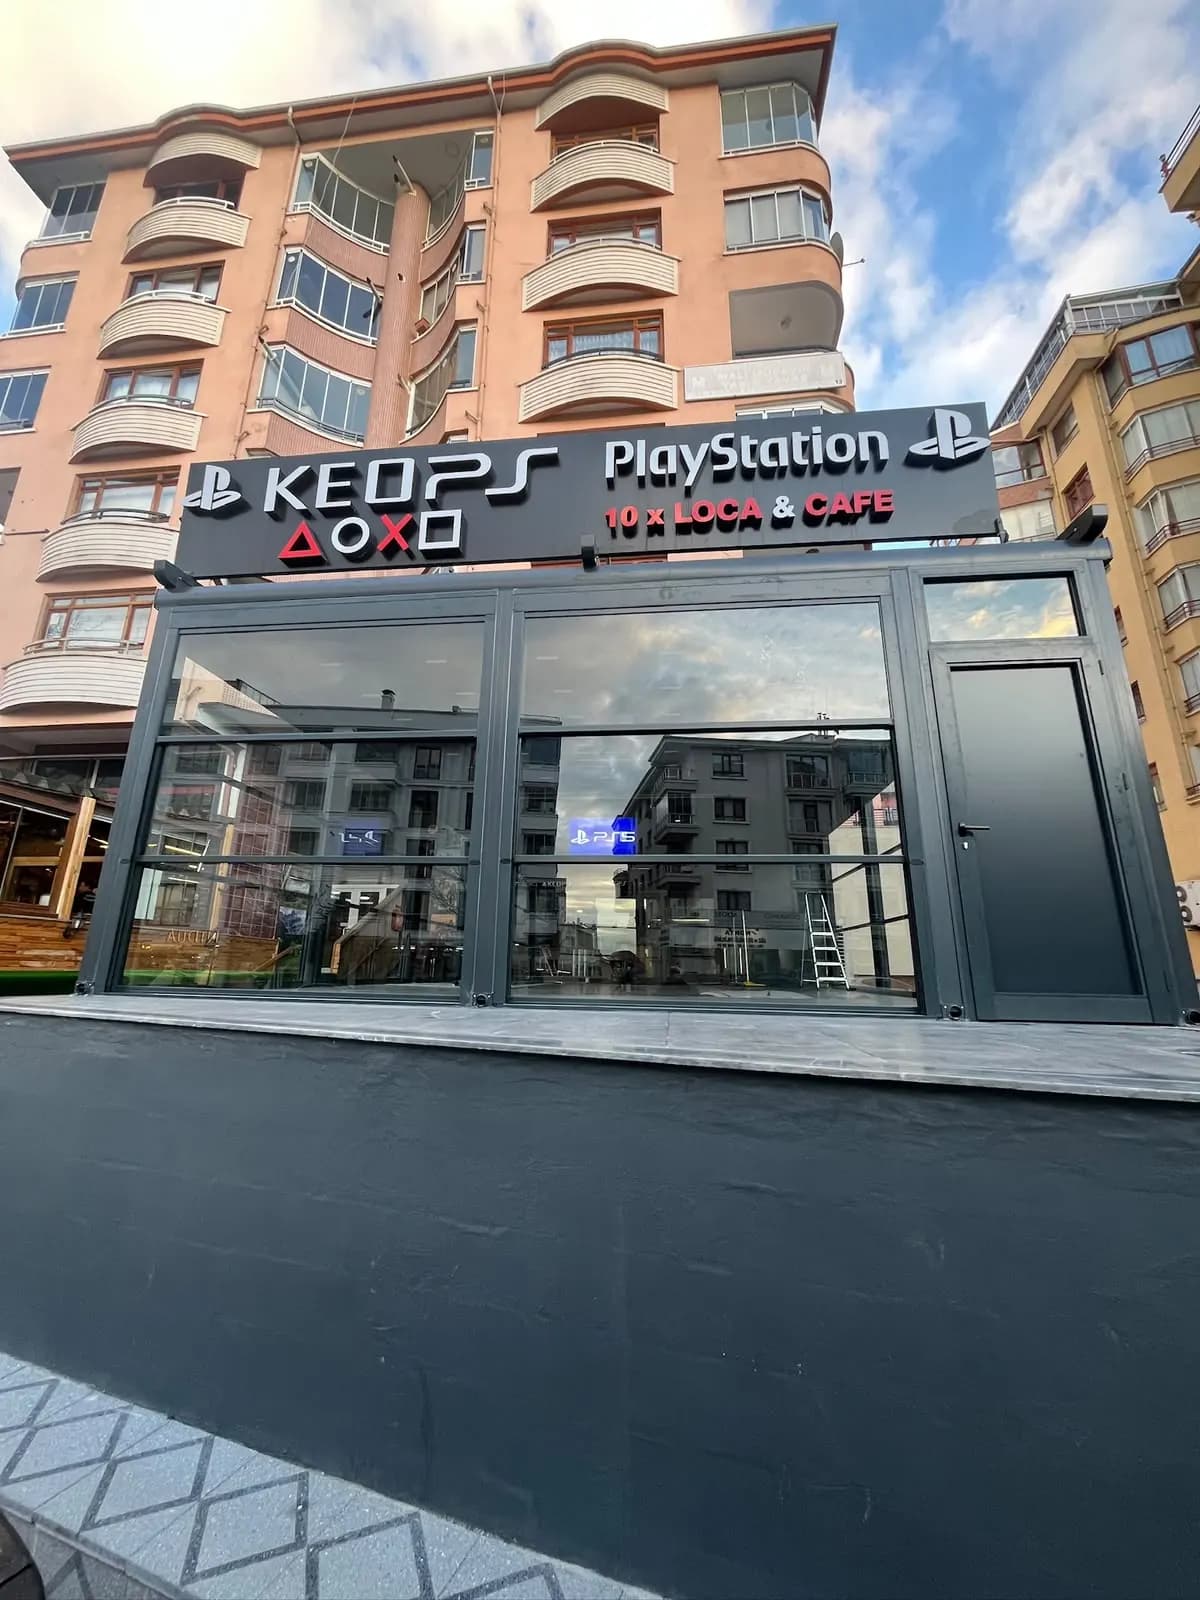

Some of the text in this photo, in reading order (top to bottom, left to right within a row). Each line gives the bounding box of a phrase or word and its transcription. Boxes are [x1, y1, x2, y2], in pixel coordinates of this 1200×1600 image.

[263, 446, 559, 513] KEOPS
[605, 426, 889, 488] PlayStation
[605, 506, 639, 528] 10
[674, 499, 763, 525] LOCA
[772, 495, 795, 519] &
[804, 489, 895, 517] CAFE
[593, 831, 636, 843] PS5
